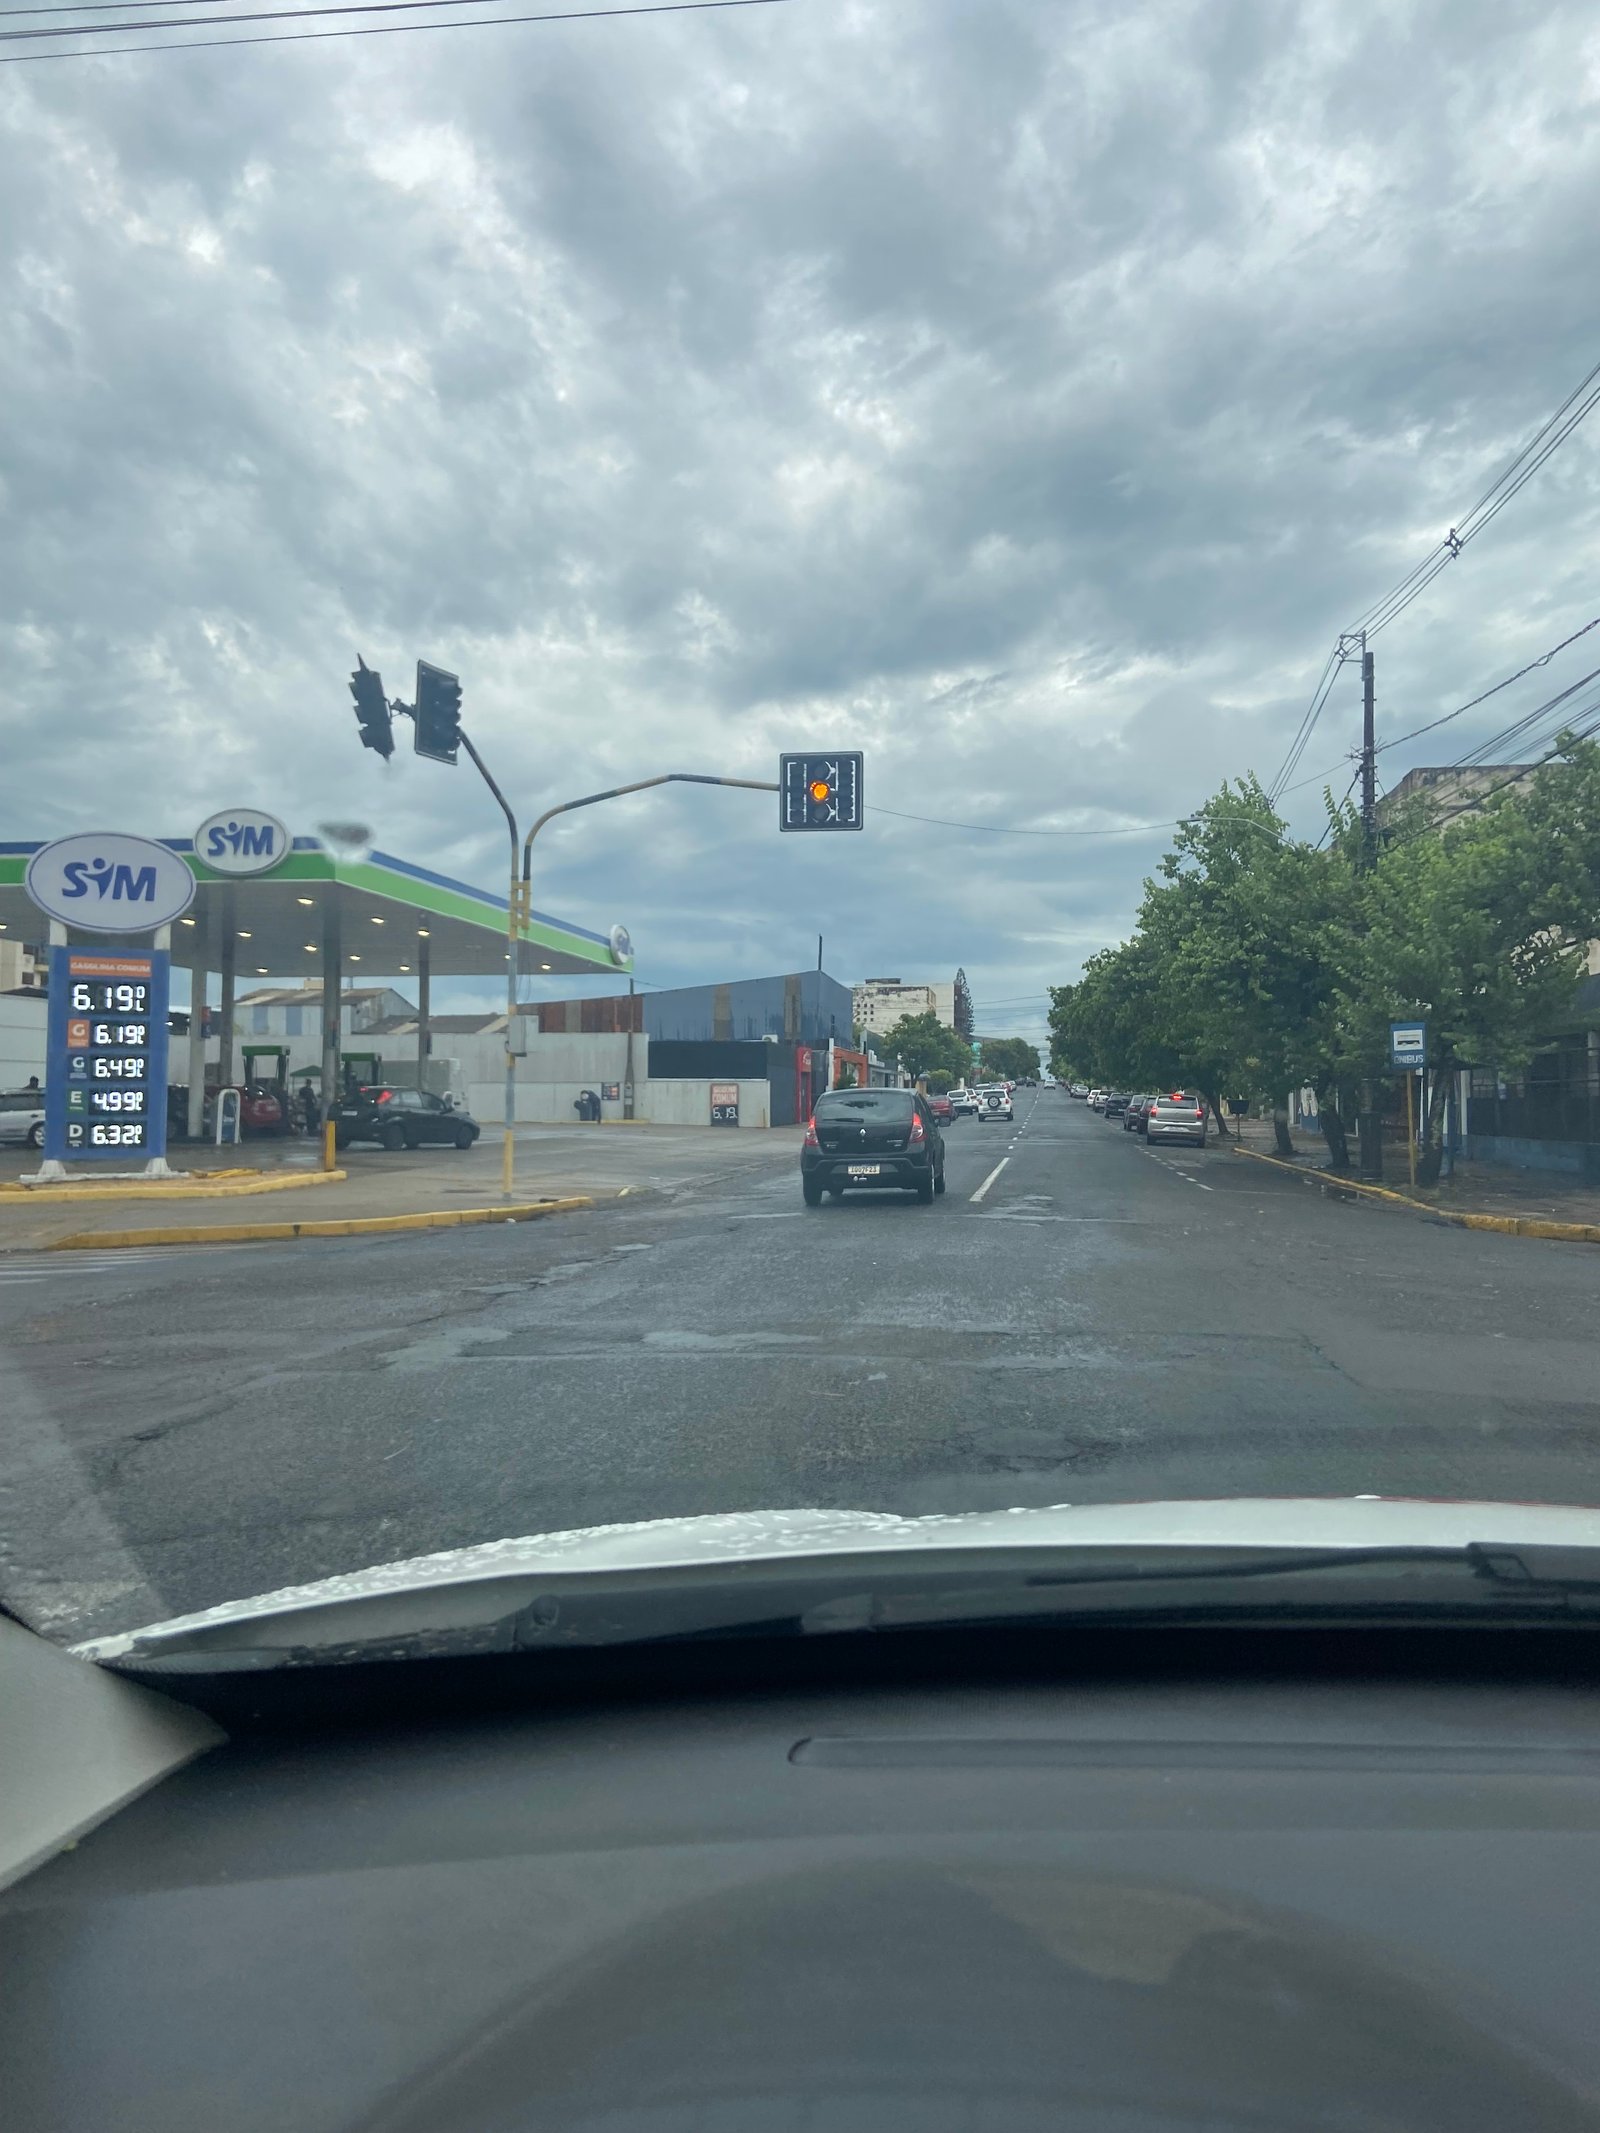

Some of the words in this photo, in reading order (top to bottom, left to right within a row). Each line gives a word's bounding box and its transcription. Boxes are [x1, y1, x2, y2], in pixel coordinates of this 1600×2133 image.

[72, 1024, 85, 1037] G
[72, 1056, 85, 1068] G
[70, 1091, 82, 1103] E
[69, 1124, 83, 1137] D
